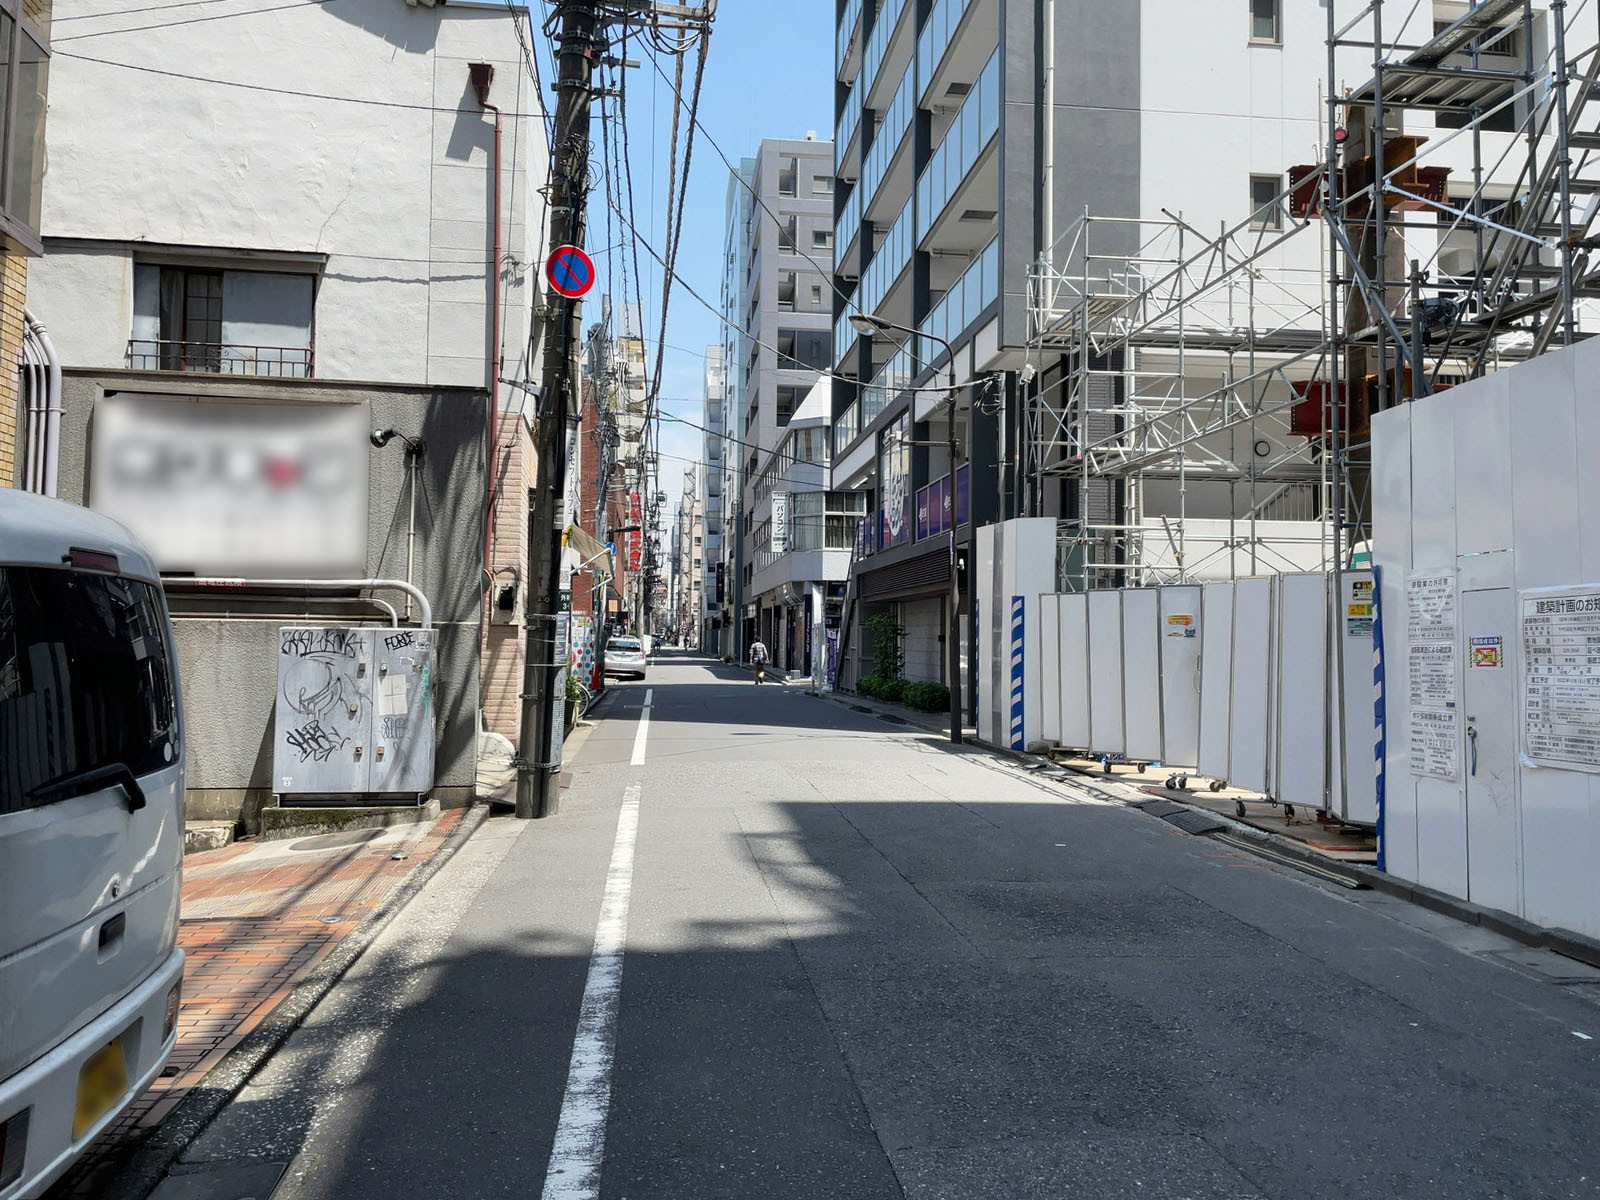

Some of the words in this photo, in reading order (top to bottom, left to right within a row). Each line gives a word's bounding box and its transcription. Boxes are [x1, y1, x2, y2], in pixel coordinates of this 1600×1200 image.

[1536, 598, 1600, 614] 建築計画のお知
